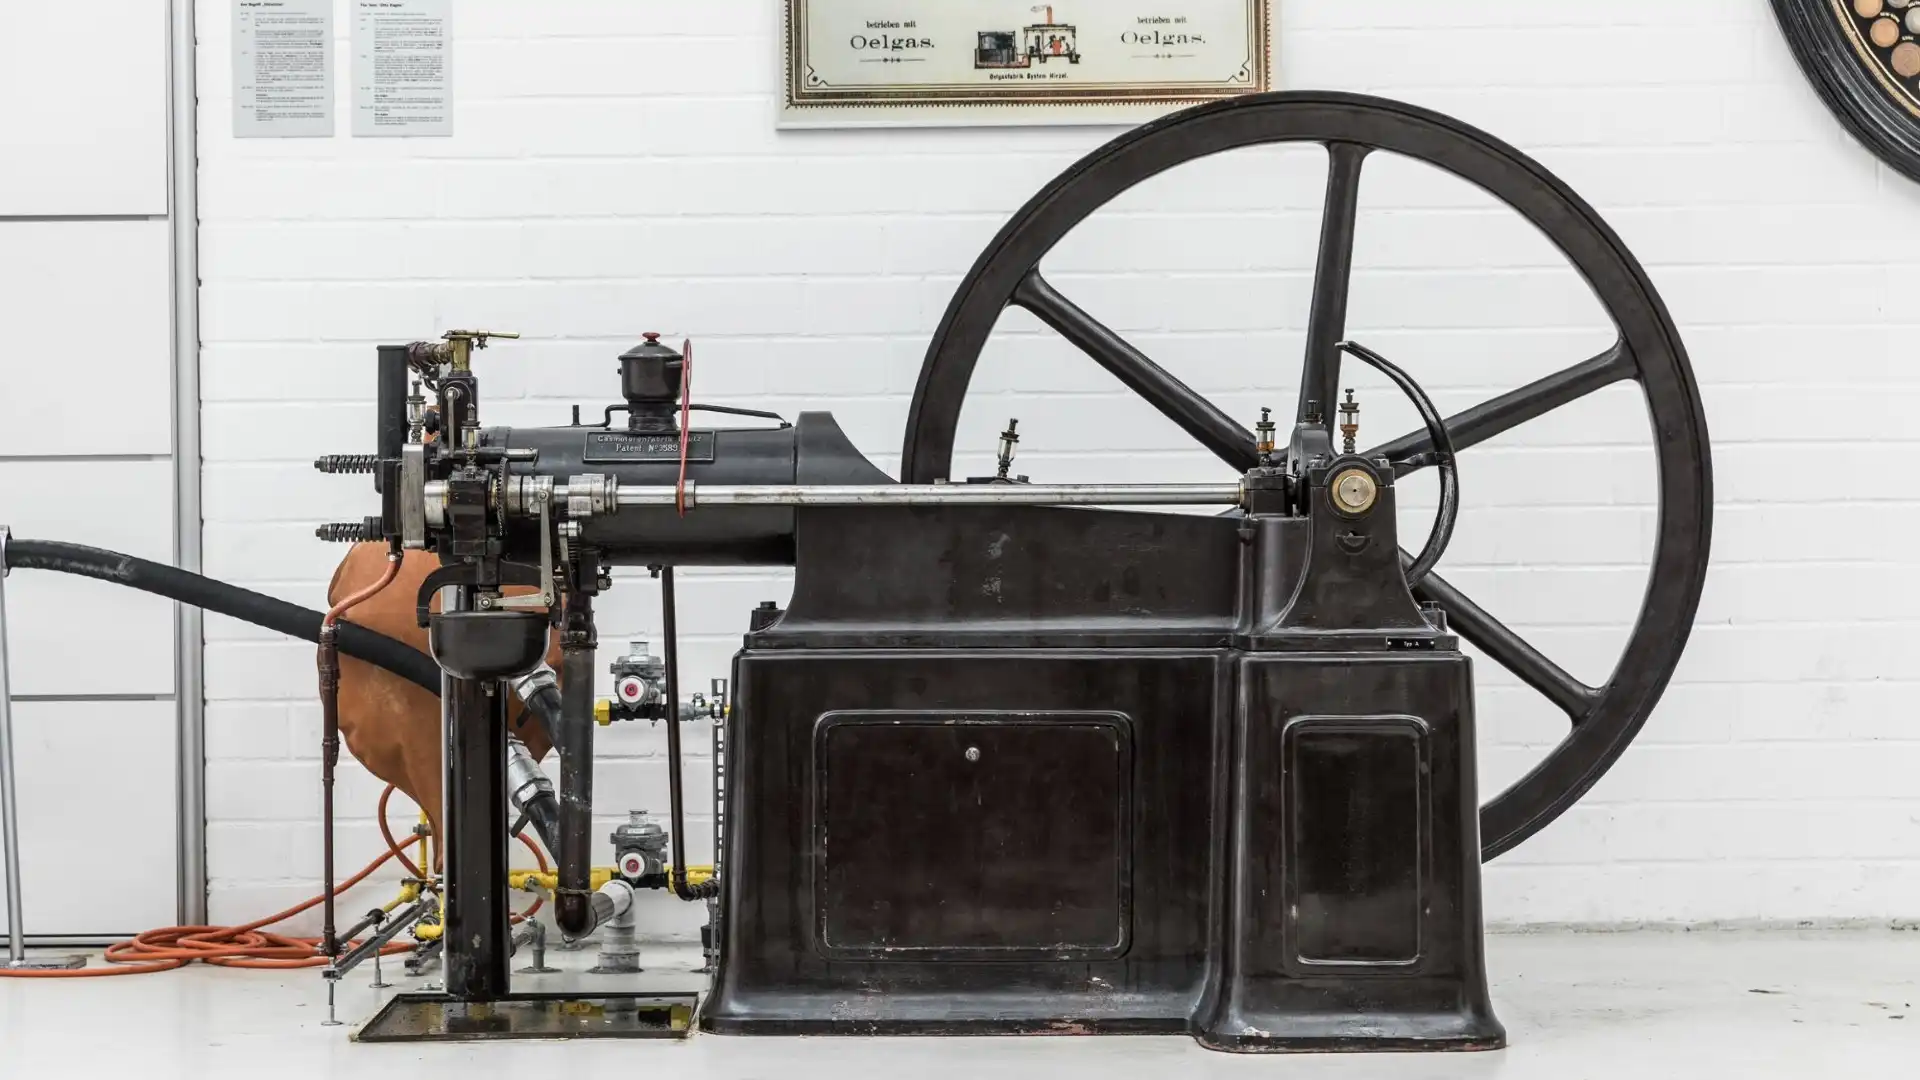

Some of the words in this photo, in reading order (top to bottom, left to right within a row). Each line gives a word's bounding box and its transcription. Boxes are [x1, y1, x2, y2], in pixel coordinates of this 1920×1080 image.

[866, 20, 900, 28] betrieben
[903, 20, 916, 28] mit
[1137, 16, 1170, 24] betrieben
[1174, 16, 1187, 24] mit
[850, 34, 934, 51] Oelgas.
[1120, 30, 1206, 47] Oelgas.
